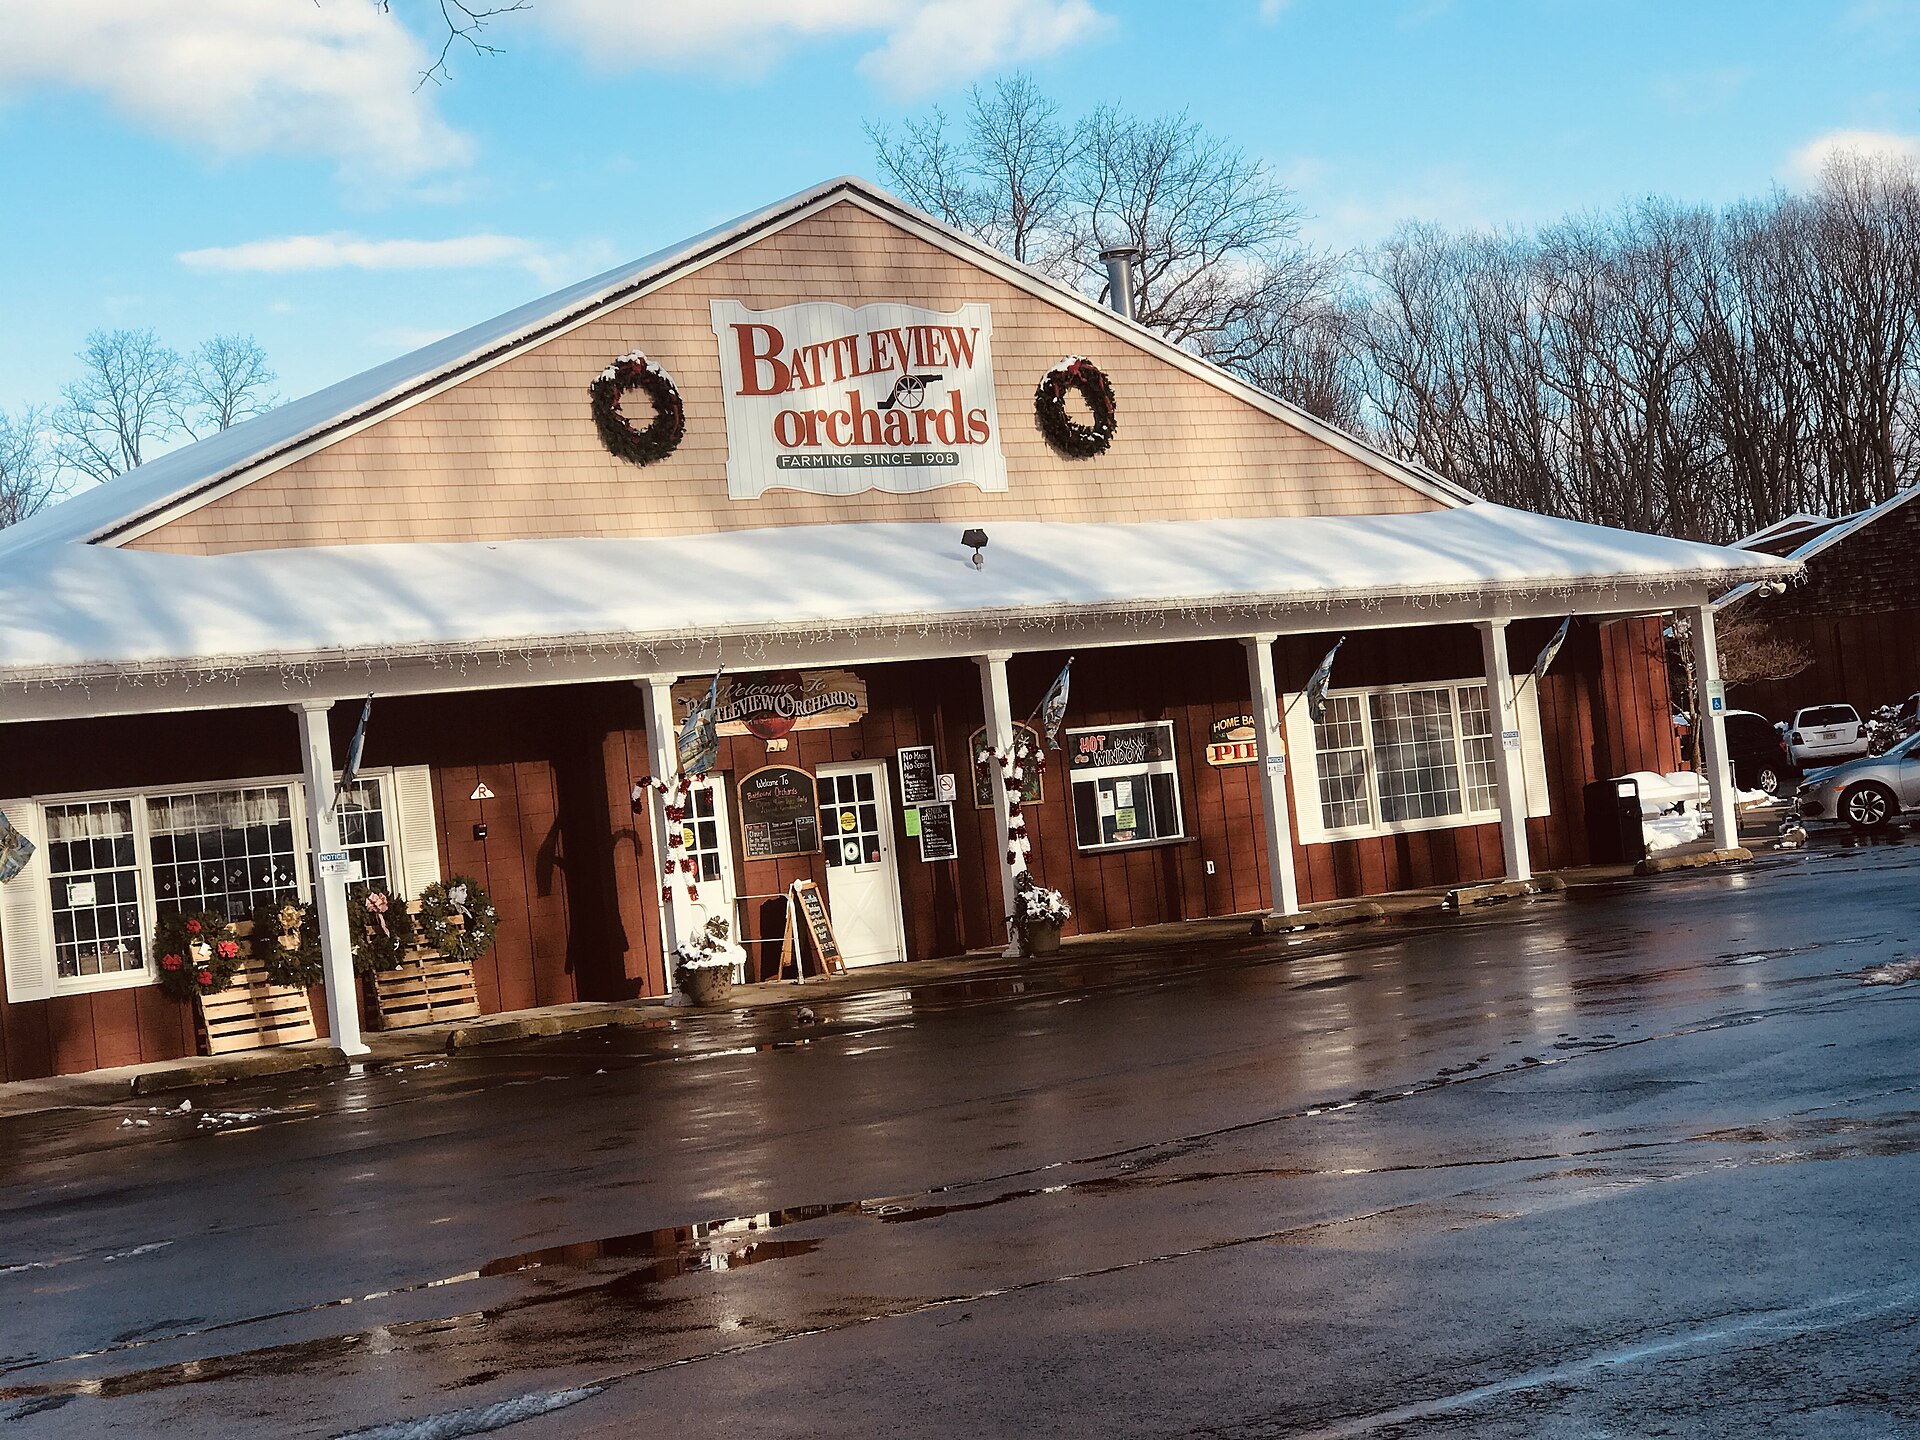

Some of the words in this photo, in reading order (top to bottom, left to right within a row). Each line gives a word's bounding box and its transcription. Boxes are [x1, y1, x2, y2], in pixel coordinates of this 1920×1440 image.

[729, 323, 980, 395] BATTLEVIEW
[774, 389, 990, 448] orchards
[782, 454, 853, 467] FARMING
[863, 453, 913, 466] SINCE
[921, 453, 955, 465] 1908
[715, 682, 798, 698] Welcome
[775, 690, 857, 718] ORCHARDS
[1213, 716, 1241, 733] HOME
[1079, 735, 1106, 753] HOT
[1093, 747, 1146, 766] WINDOW
[478, 786, 487, 798] R
[756, 778, 779, 789] Welcome
[320, 852, 346, 861] NOTICE
